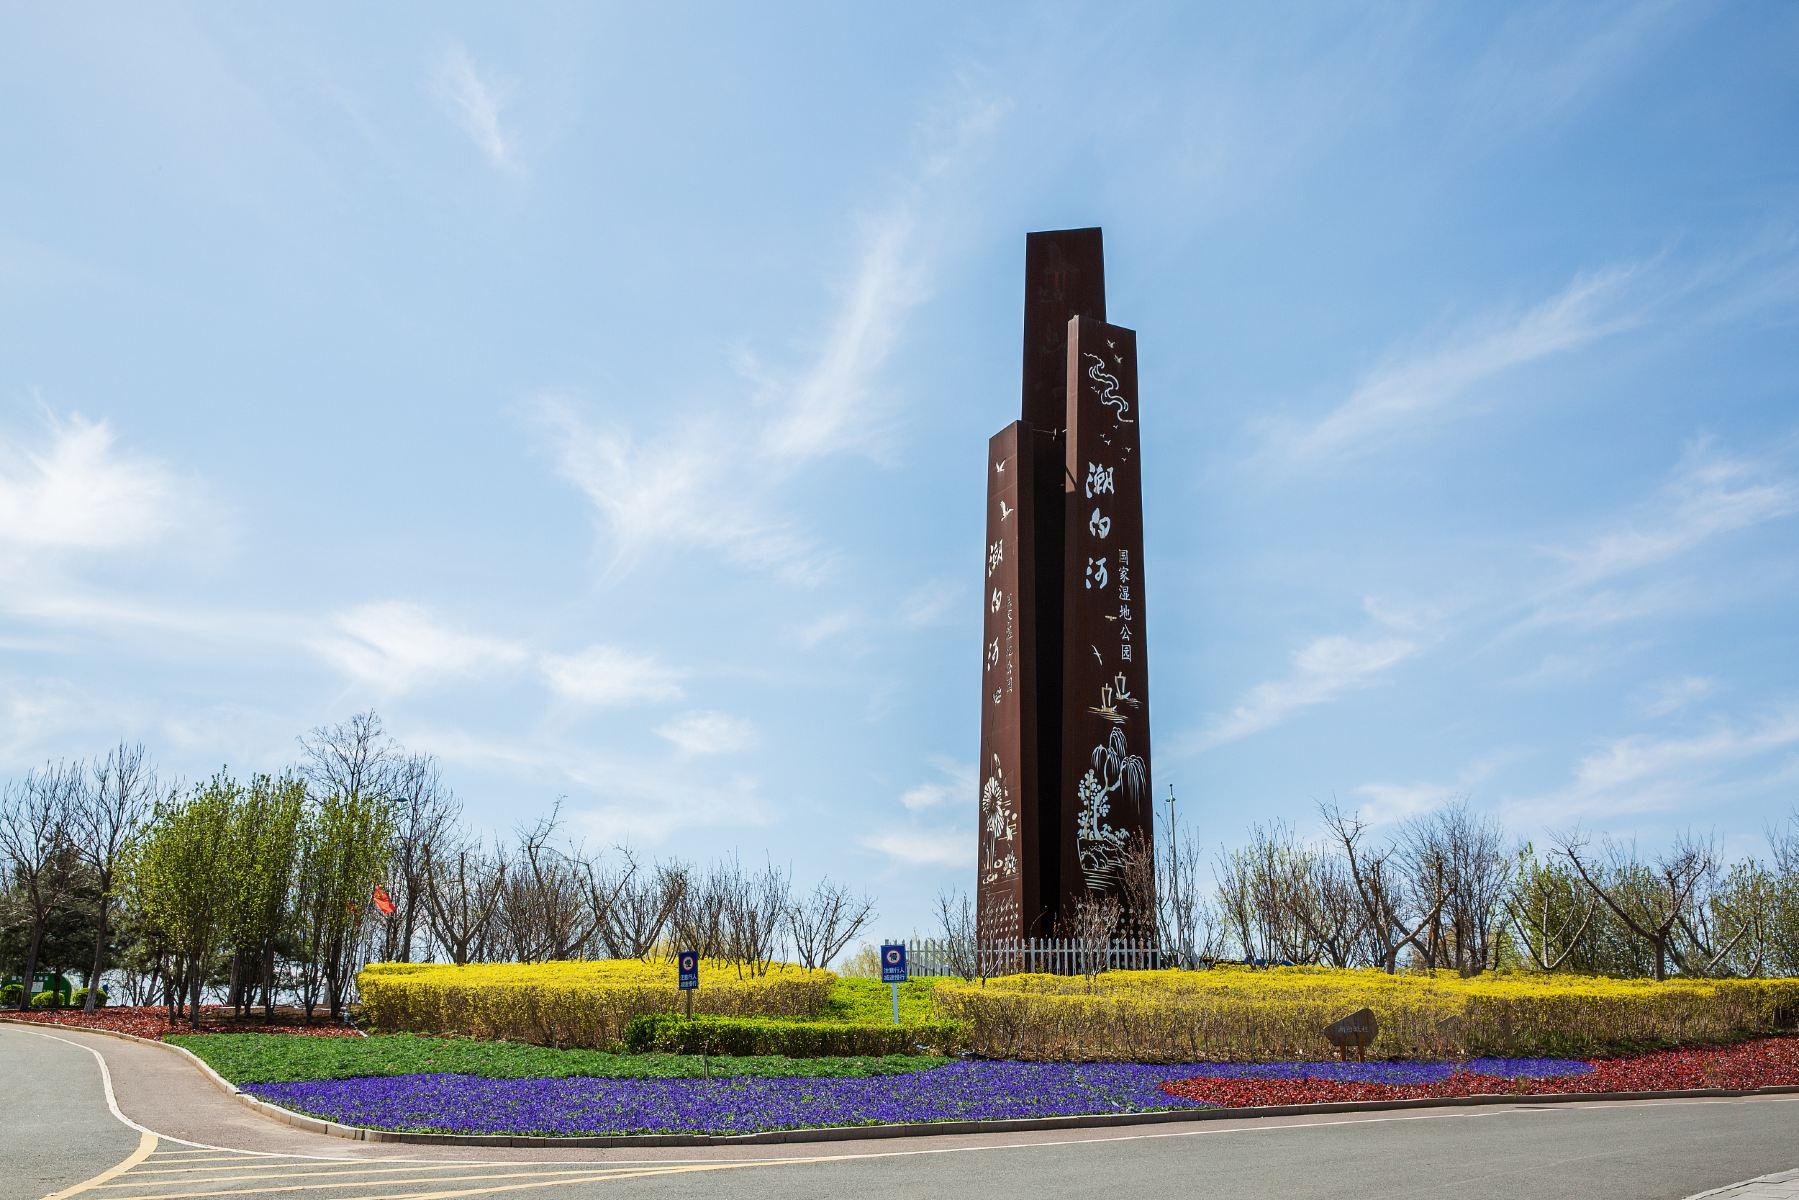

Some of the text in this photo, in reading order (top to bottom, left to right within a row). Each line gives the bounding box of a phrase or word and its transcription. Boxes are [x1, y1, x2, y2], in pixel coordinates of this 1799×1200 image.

[1085, 461, 1115, 590] 潮白河
[1118, 548, 1132, 662] 国家湿地公园
